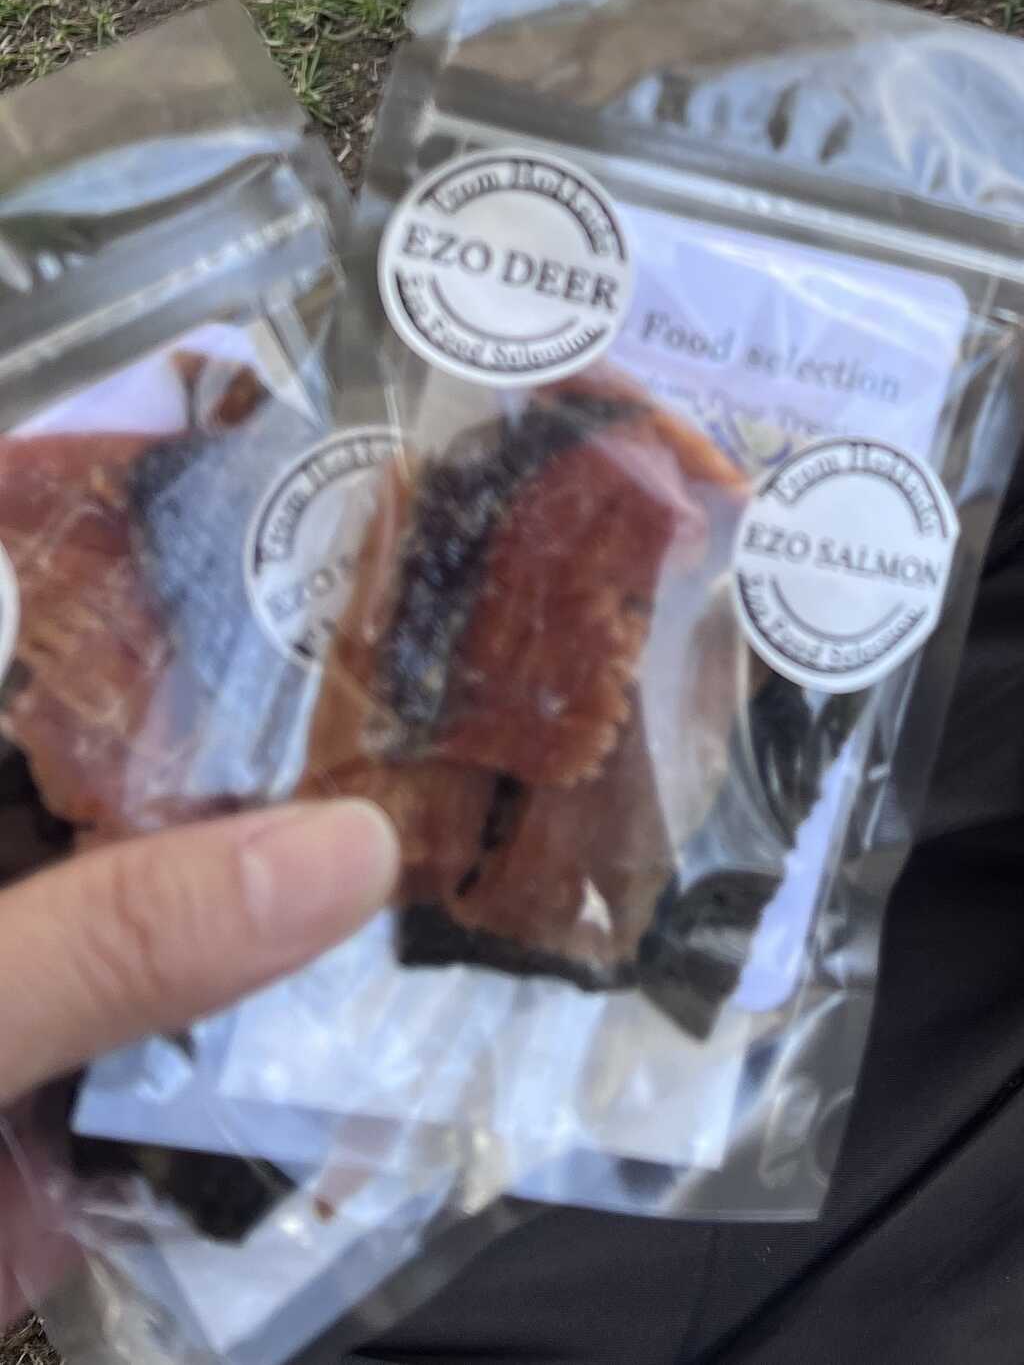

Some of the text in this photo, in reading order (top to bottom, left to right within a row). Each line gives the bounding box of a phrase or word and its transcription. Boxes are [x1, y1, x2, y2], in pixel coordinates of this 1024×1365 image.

[402, 224, 621, 310] EZO DEER
[640, 312, 735, 364] Food
[744, 520, 940, 586] EZO SALMON
